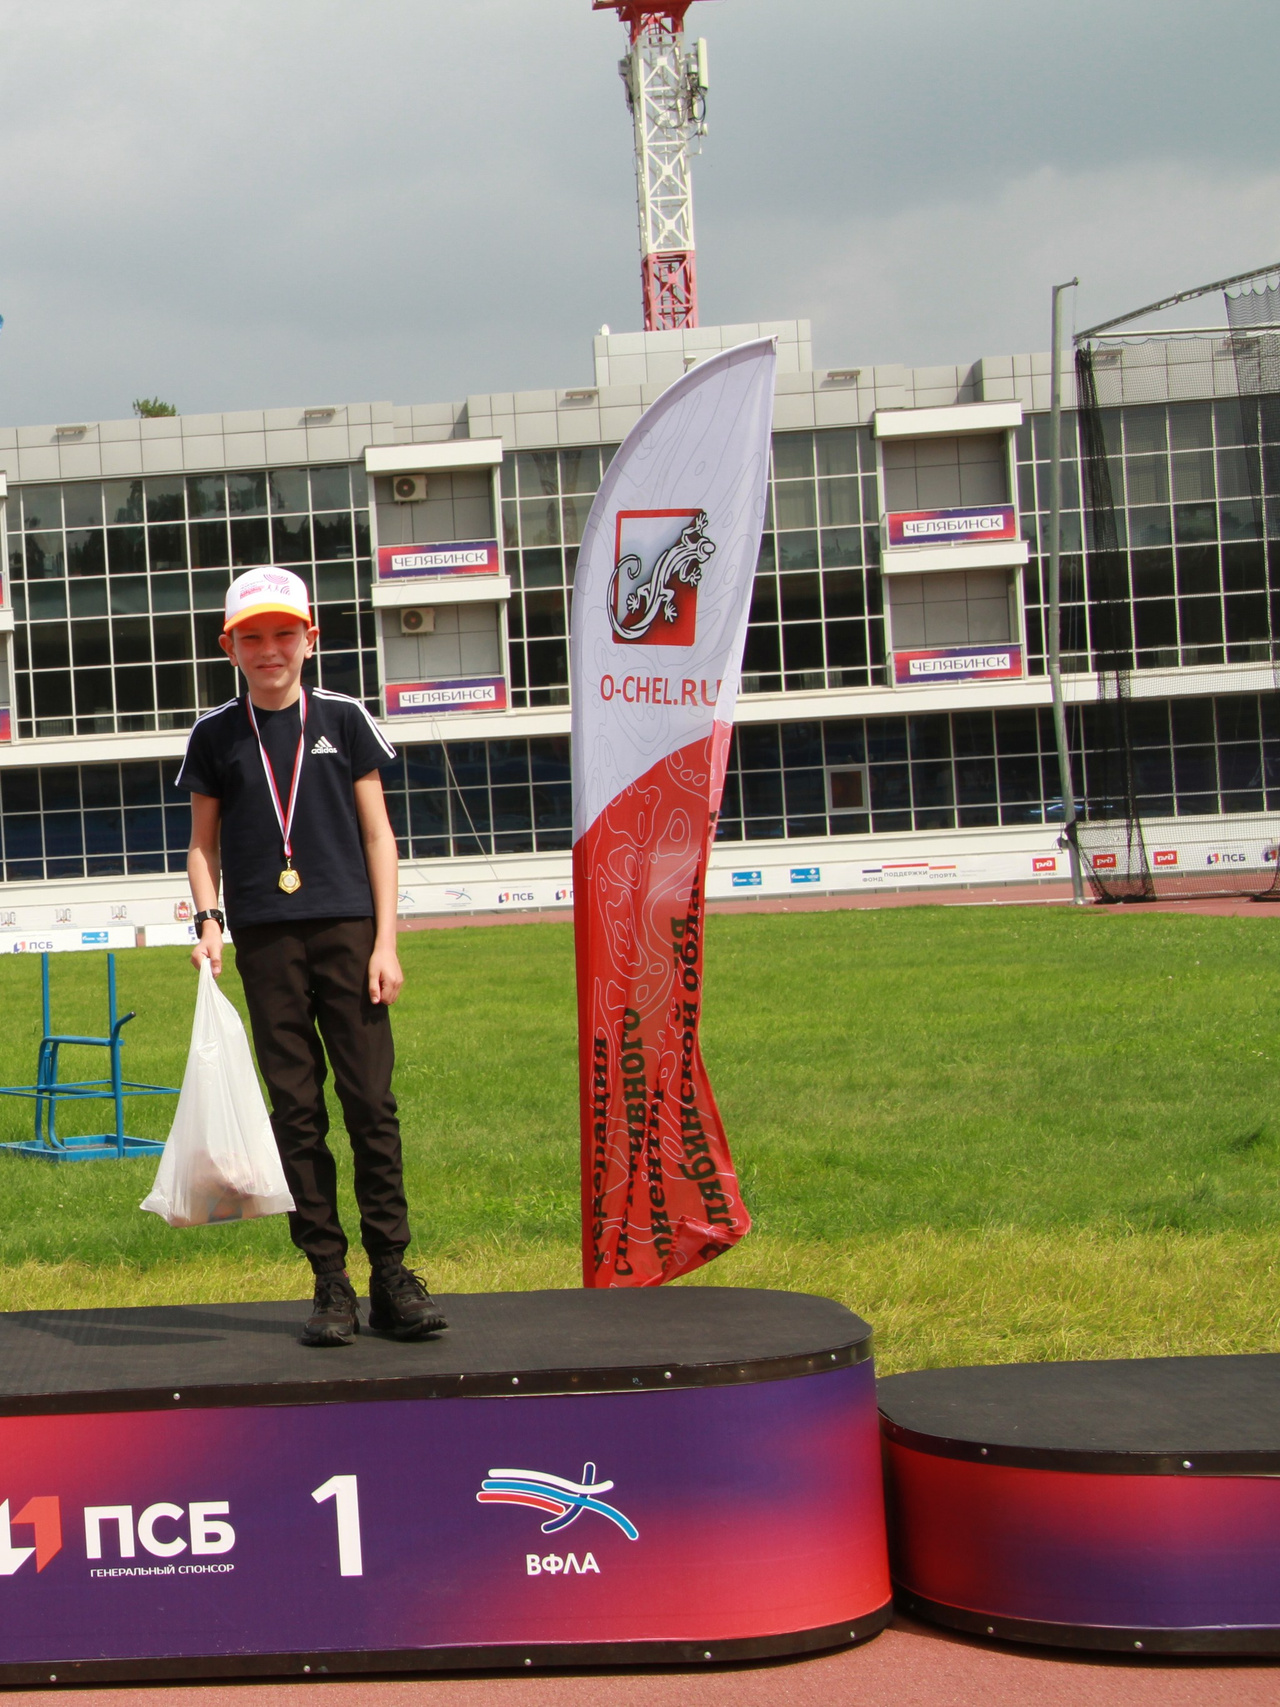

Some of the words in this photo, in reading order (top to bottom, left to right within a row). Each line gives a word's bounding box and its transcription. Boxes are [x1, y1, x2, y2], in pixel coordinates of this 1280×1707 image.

[905, 516, 1001, 534] ЧЕЛЯБИНСК
[394, 551, 485, 567] ЧЕЛЯБИНСК
[911, 655, 1009, 672] ЧЕЛЯБИНСК
[401, 687, 493, 704] ЧЕЛЯБИНСК
[600, 674, 723, 707] O-CHEL.RU
[310, 746, 338, 755] adidas
[1222, 853, 1246, 862] ПСБ
[512, 892, 534, 901] ПСБ
[29, 941, 54, 950] ПСБ
[675, 1000, 734, 1235] лябинской
[83, 1500, 236, 1560] ПСБ
[310, 1474, 365, 1577] 1
[90, 1563, 176, 1578] ГЕНЕРАЛЬНЫЙ
[178, 1563, 235, 1575] СПОНСОР
[525, 1552, 601, 1576] ВФЛА
